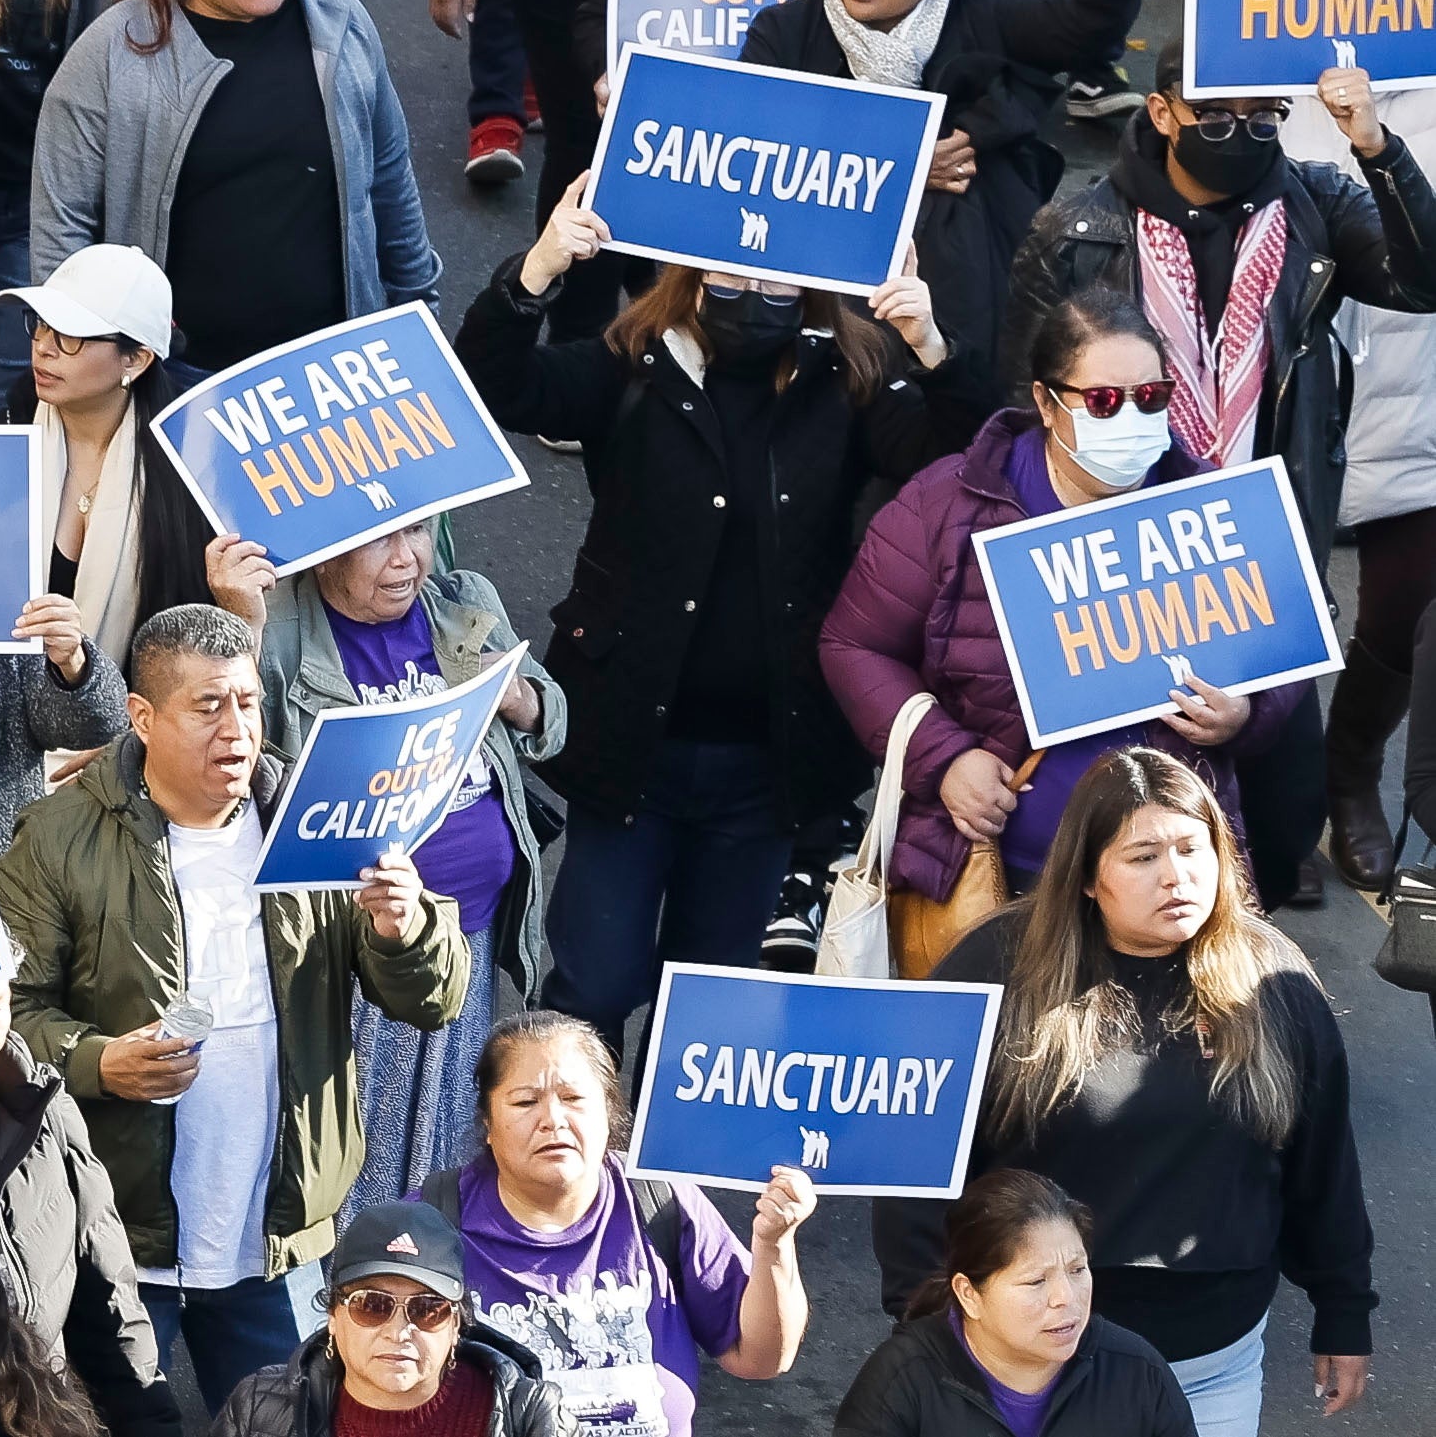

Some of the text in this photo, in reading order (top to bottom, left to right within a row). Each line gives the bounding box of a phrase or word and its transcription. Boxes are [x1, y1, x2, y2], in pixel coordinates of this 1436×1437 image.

[635, 6, 759, 48] CALIF
[624, 117, 897, 217] SANCTUARY
[202, 339, 414, 457] WE ARE
[240, 391, 460, 517] HUMAN
[1028, 498, 1247, 606] WE ARE
[1053, 559, 1276, 678] HUMAN
[368, 762, 428, 797] OUT
[396, 707, 463, 768] ICE
[675, 1040, 954, 1118] SANCTUARY
